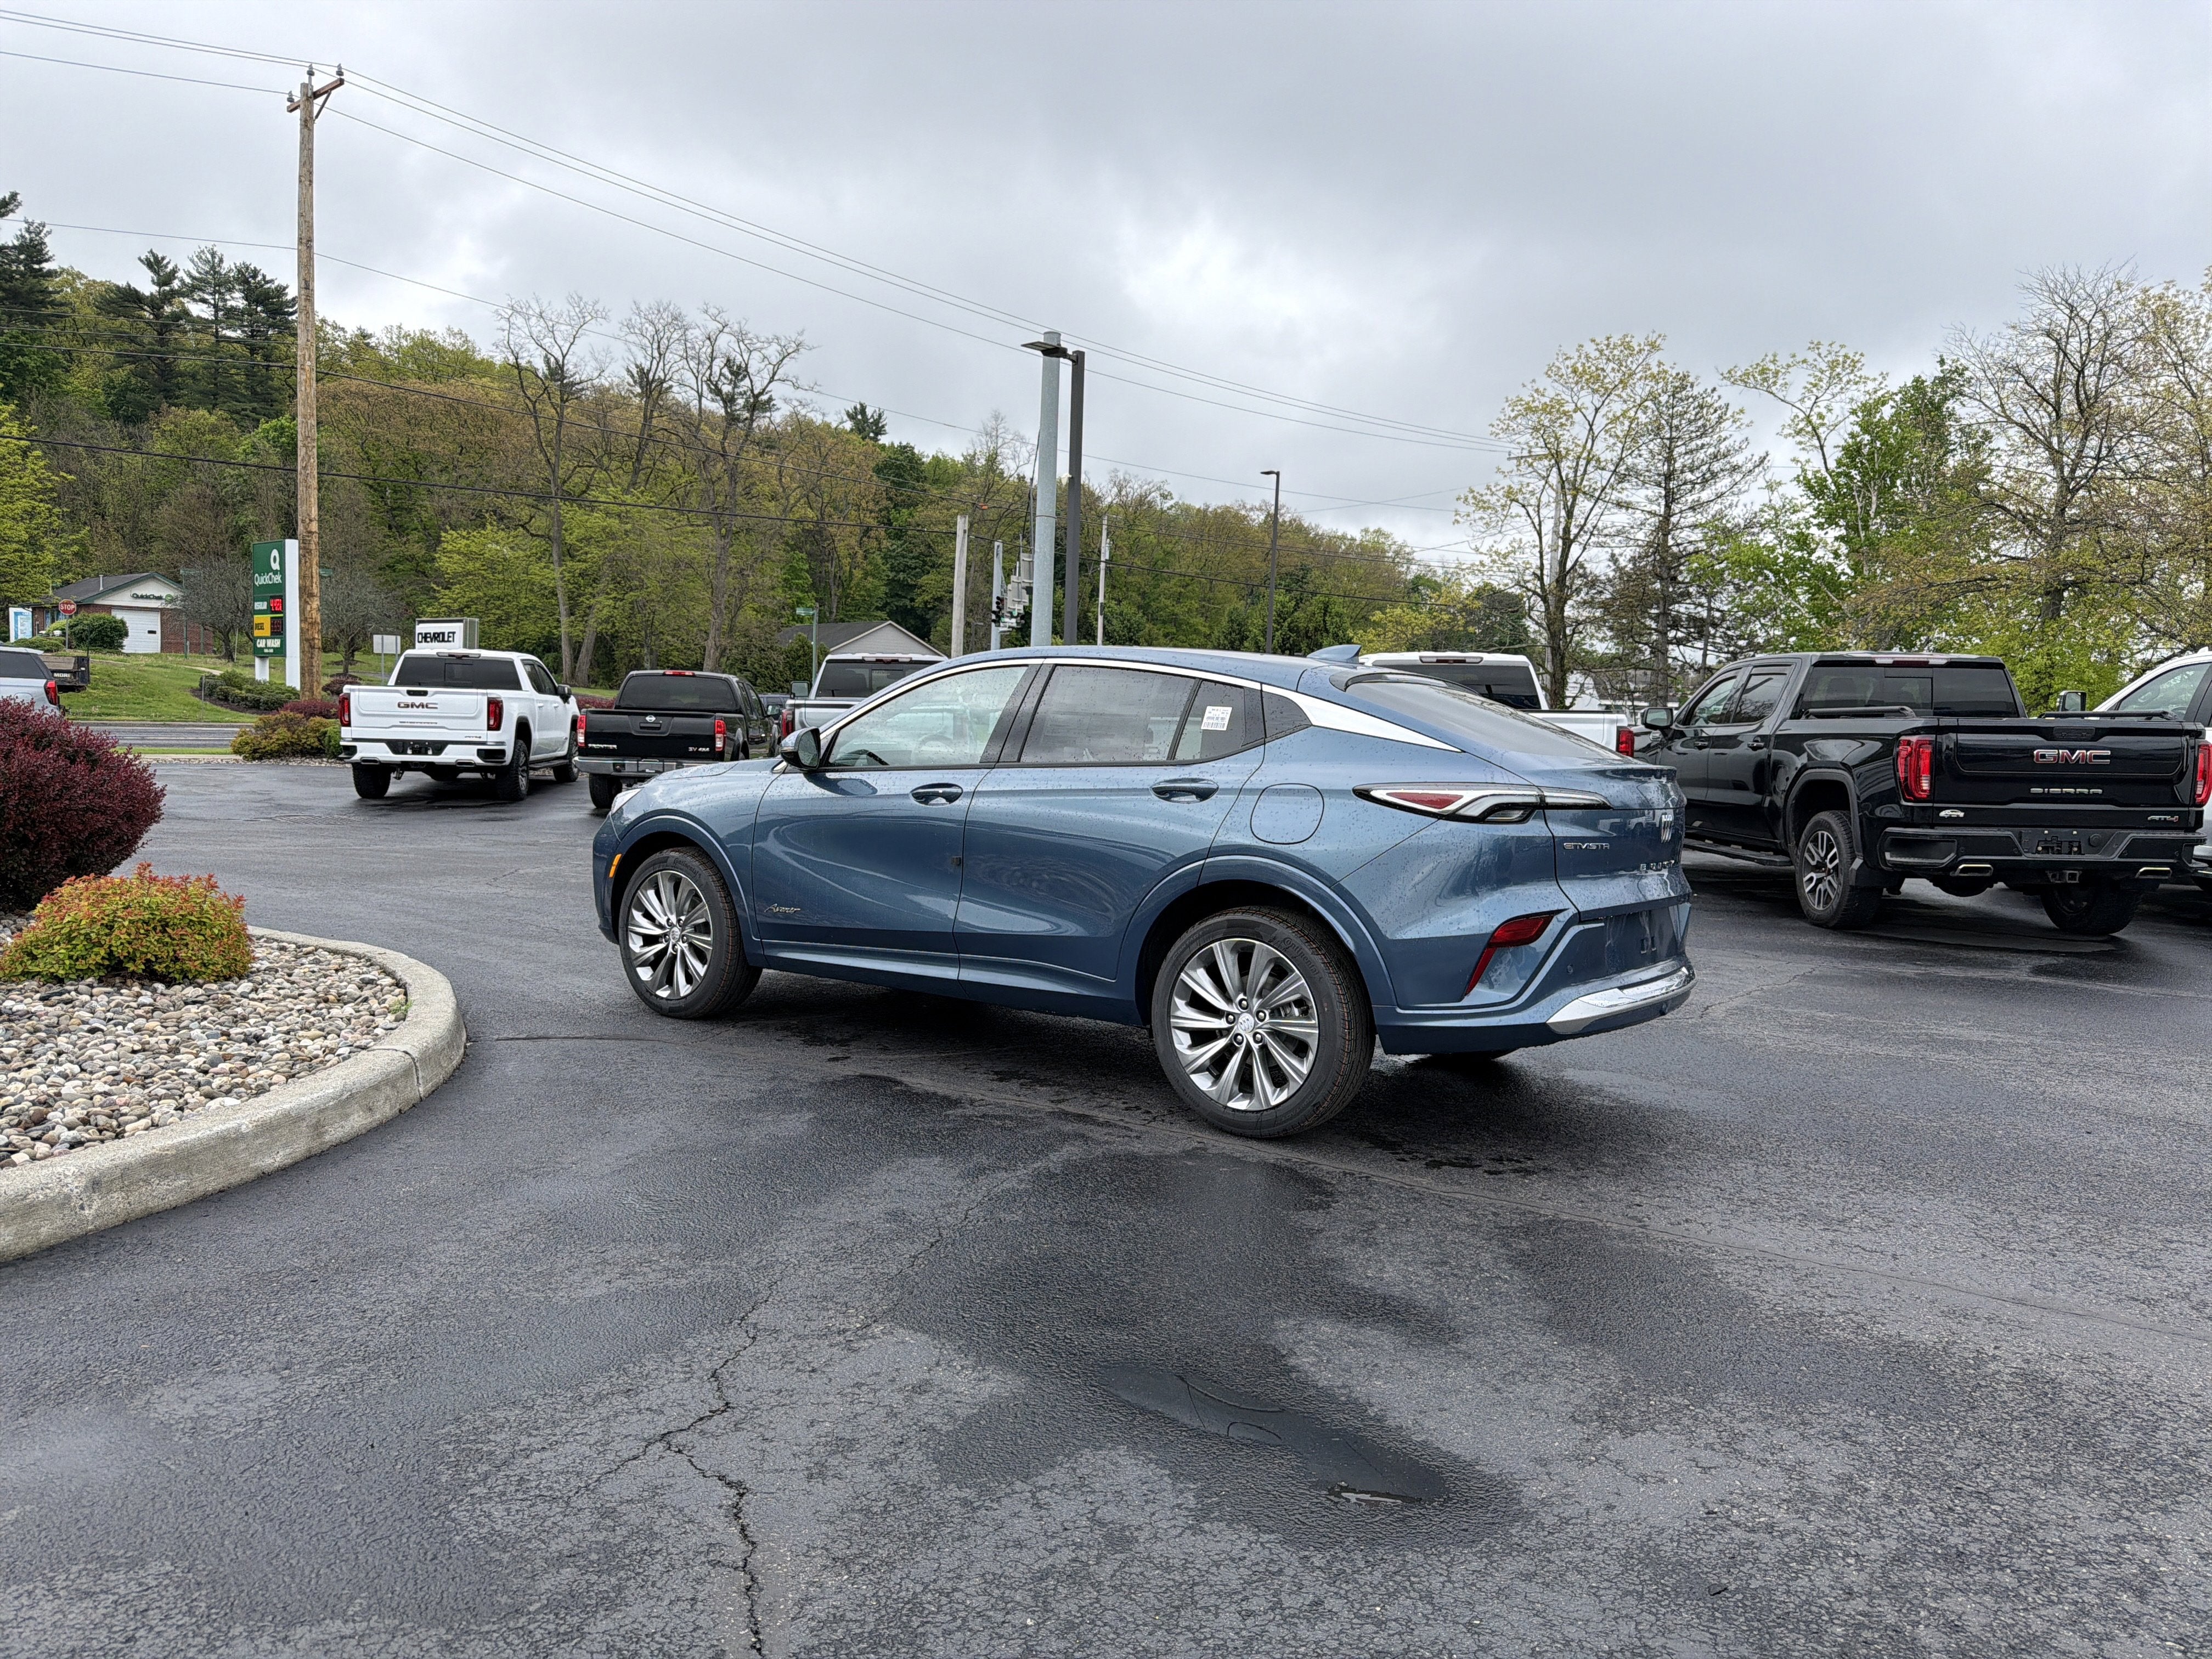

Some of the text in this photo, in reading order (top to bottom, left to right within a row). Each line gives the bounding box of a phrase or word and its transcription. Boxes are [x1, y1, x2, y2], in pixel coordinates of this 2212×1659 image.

[270, 549, 280, 571] Q
[254, 572, 282, 587] QuickChek
[256, 639, 281, 648] CAR WASH
[417, 631, 456, 644] CHEVROLET
[2033, 749, 2111, 765] GMC
[673, 857, 699, 877] Continental
[1284, 937, 1320, 975] Continental
